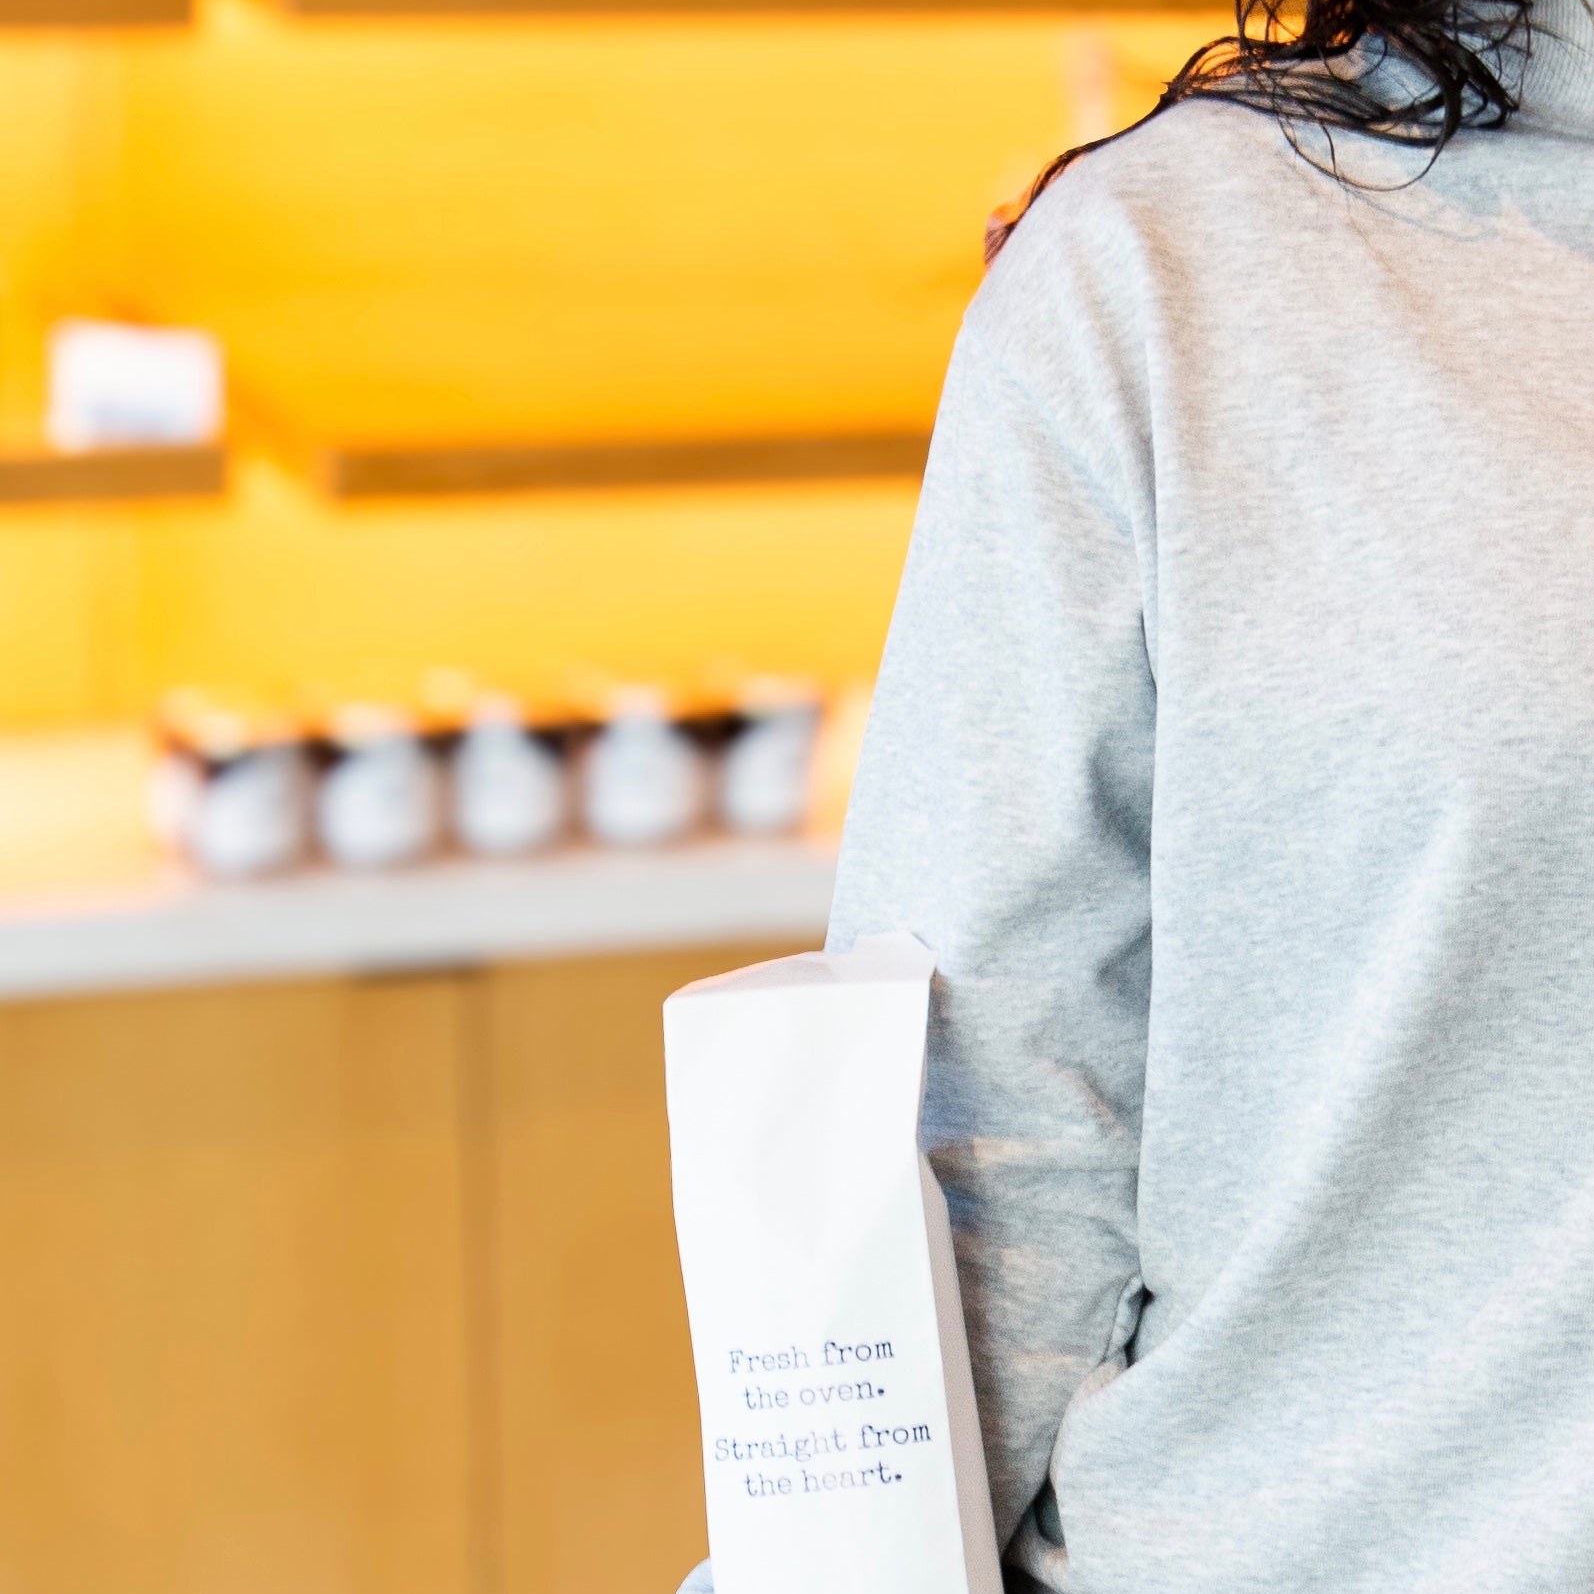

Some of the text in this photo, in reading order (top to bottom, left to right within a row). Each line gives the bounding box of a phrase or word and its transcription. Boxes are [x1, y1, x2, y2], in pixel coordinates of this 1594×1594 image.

[728, 1340, 895, 1374] Fresh from
[743, 1380, 885, 1410] the oven.
[714, 1423, 932, 1462] Straight from
[744, 1460, 902, 1497] the heart.
